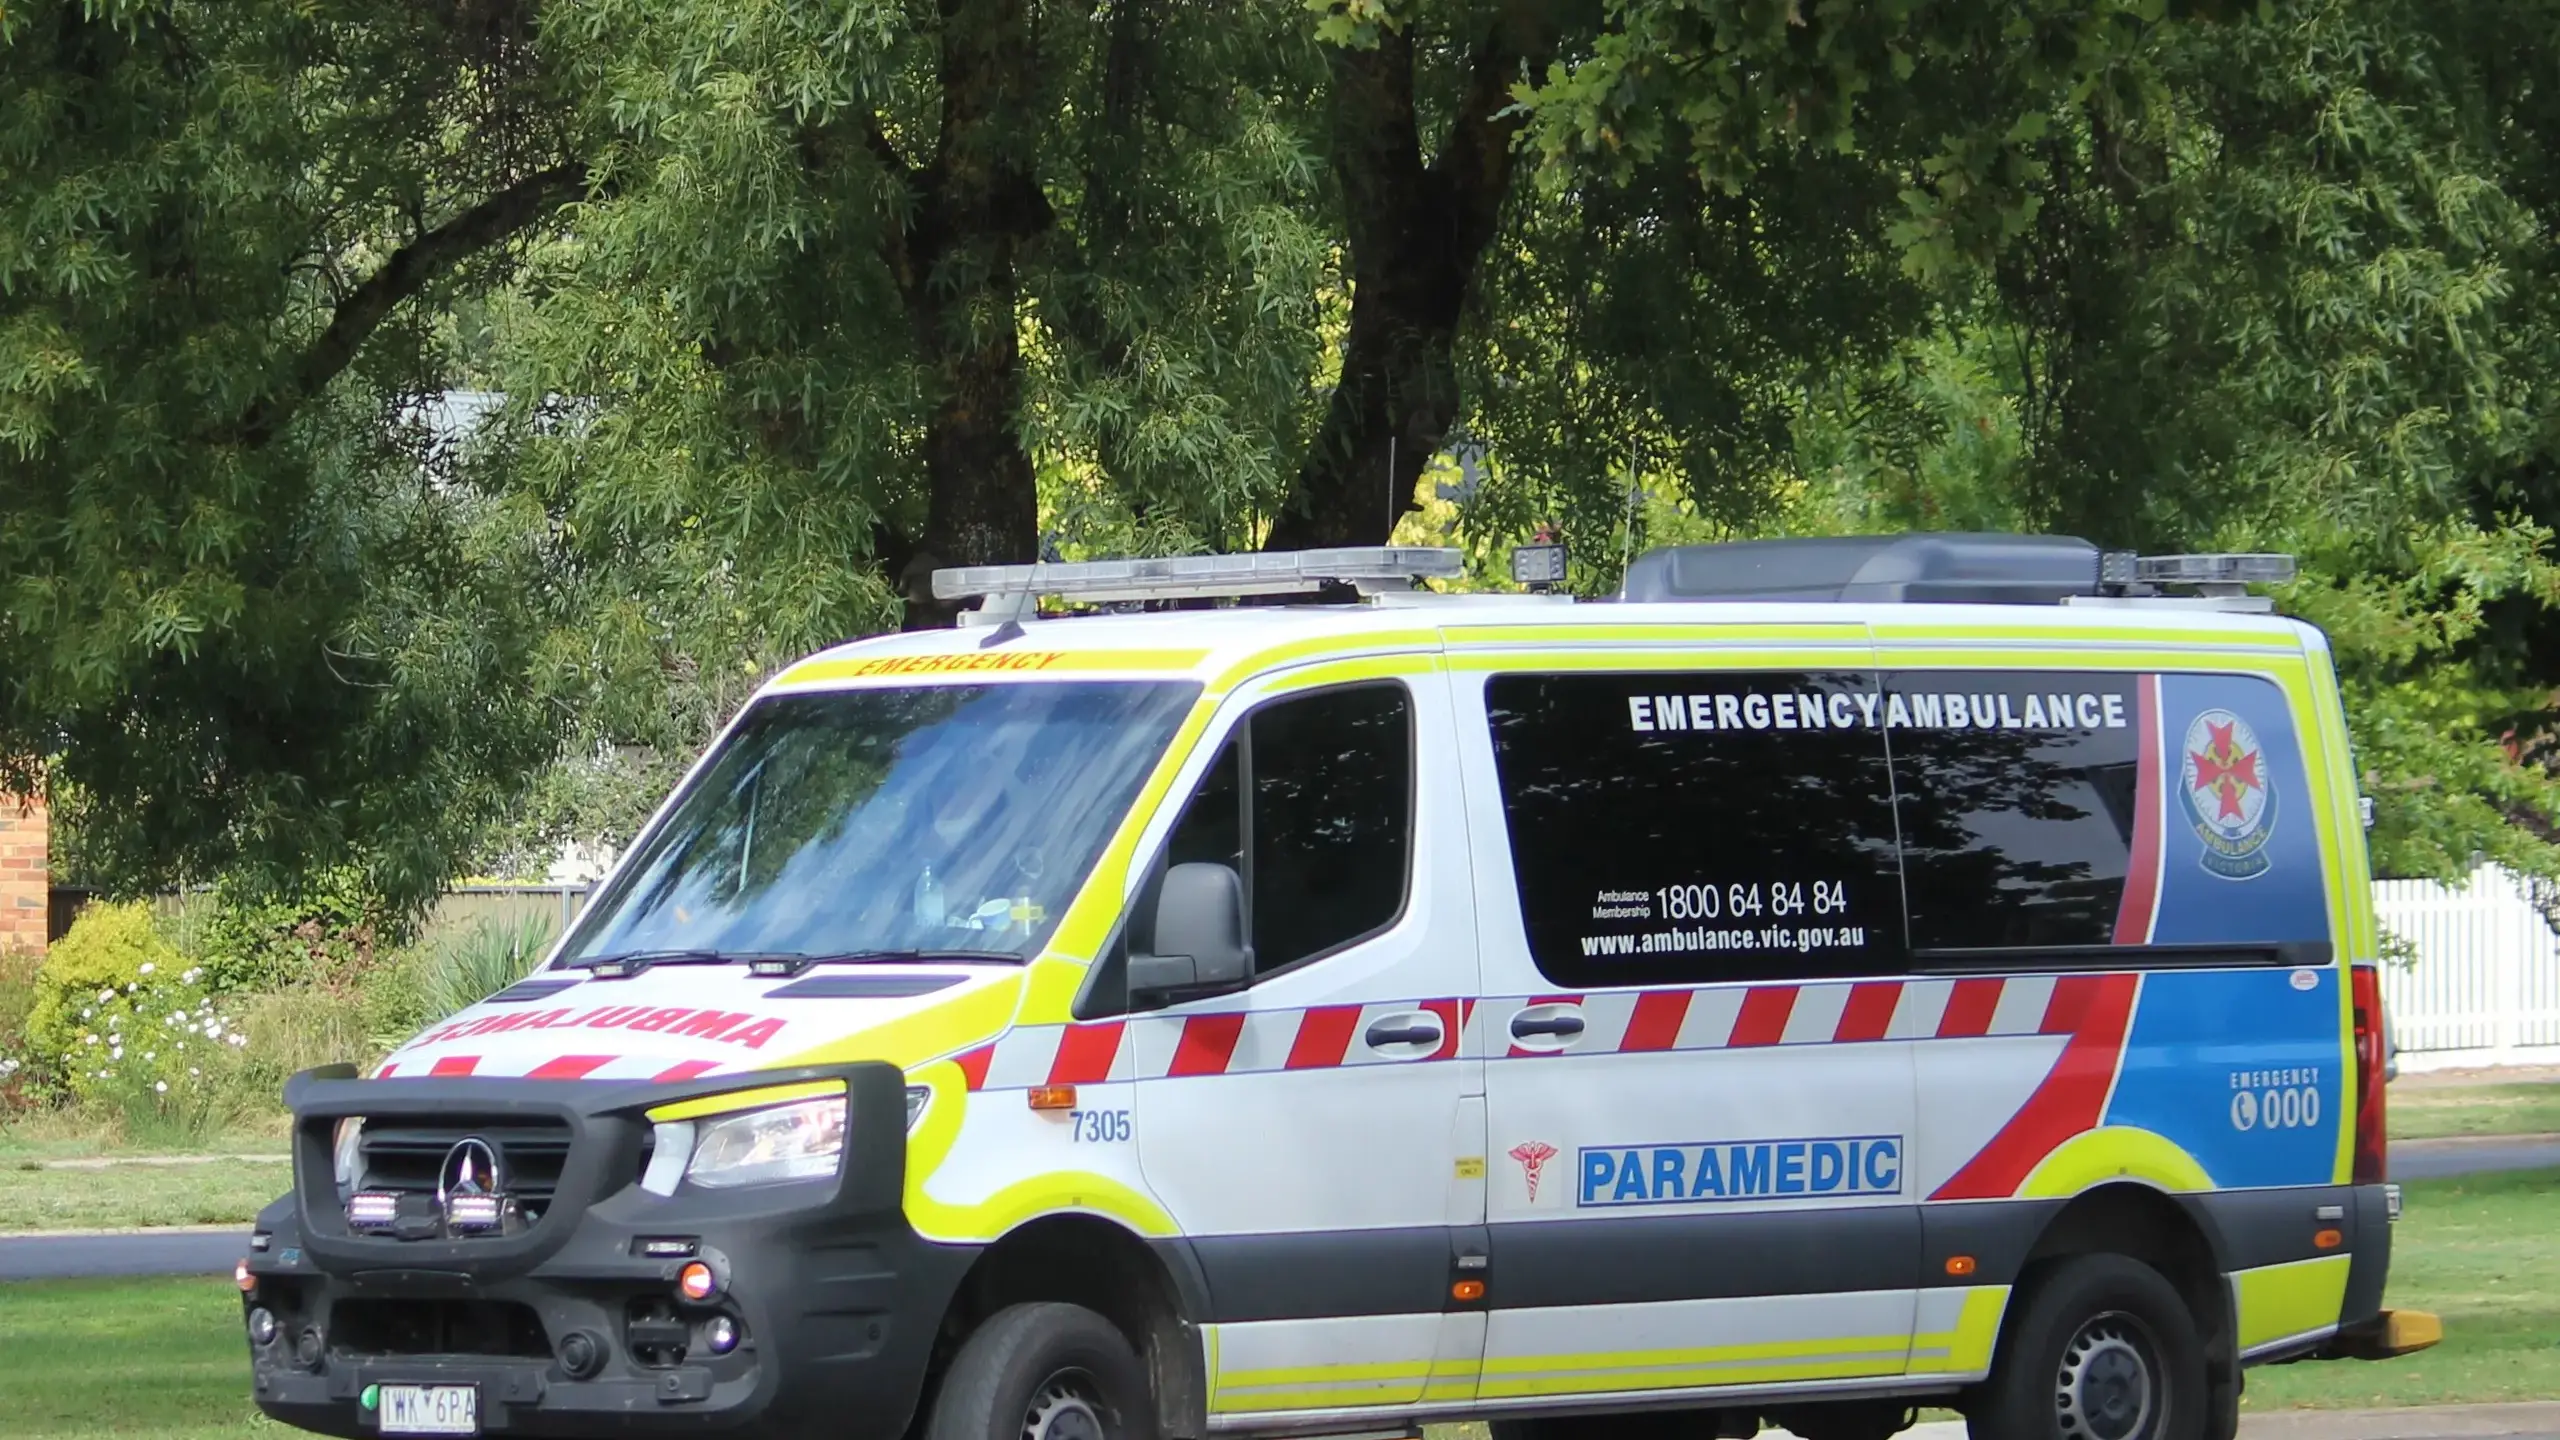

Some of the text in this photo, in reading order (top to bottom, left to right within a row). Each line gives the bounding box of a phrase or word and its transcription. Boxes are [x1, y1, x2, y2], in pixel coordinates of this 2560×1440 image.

[854, 653, 1065, 676] EMERGENCY
[1628, 692, 2127, 731] EMERGENCY AMBULANCE
[1593, 903, 1651, 919] Membership
[1598, 890, 1649, 903] Ambulance
[1656, 880, 1847, 919] 1800 64 84 84
[1581, 924, 1864, 956] www.ambulance.vic.gov.au
[2230, 1067, 2320, 1089] EMERGENCY
[2262, 1086, 2320, 1129] 000
[1069, 1110, 1131, 1142] 7305
[1583, 1139, 1897, 1202] PARAMEDIC
